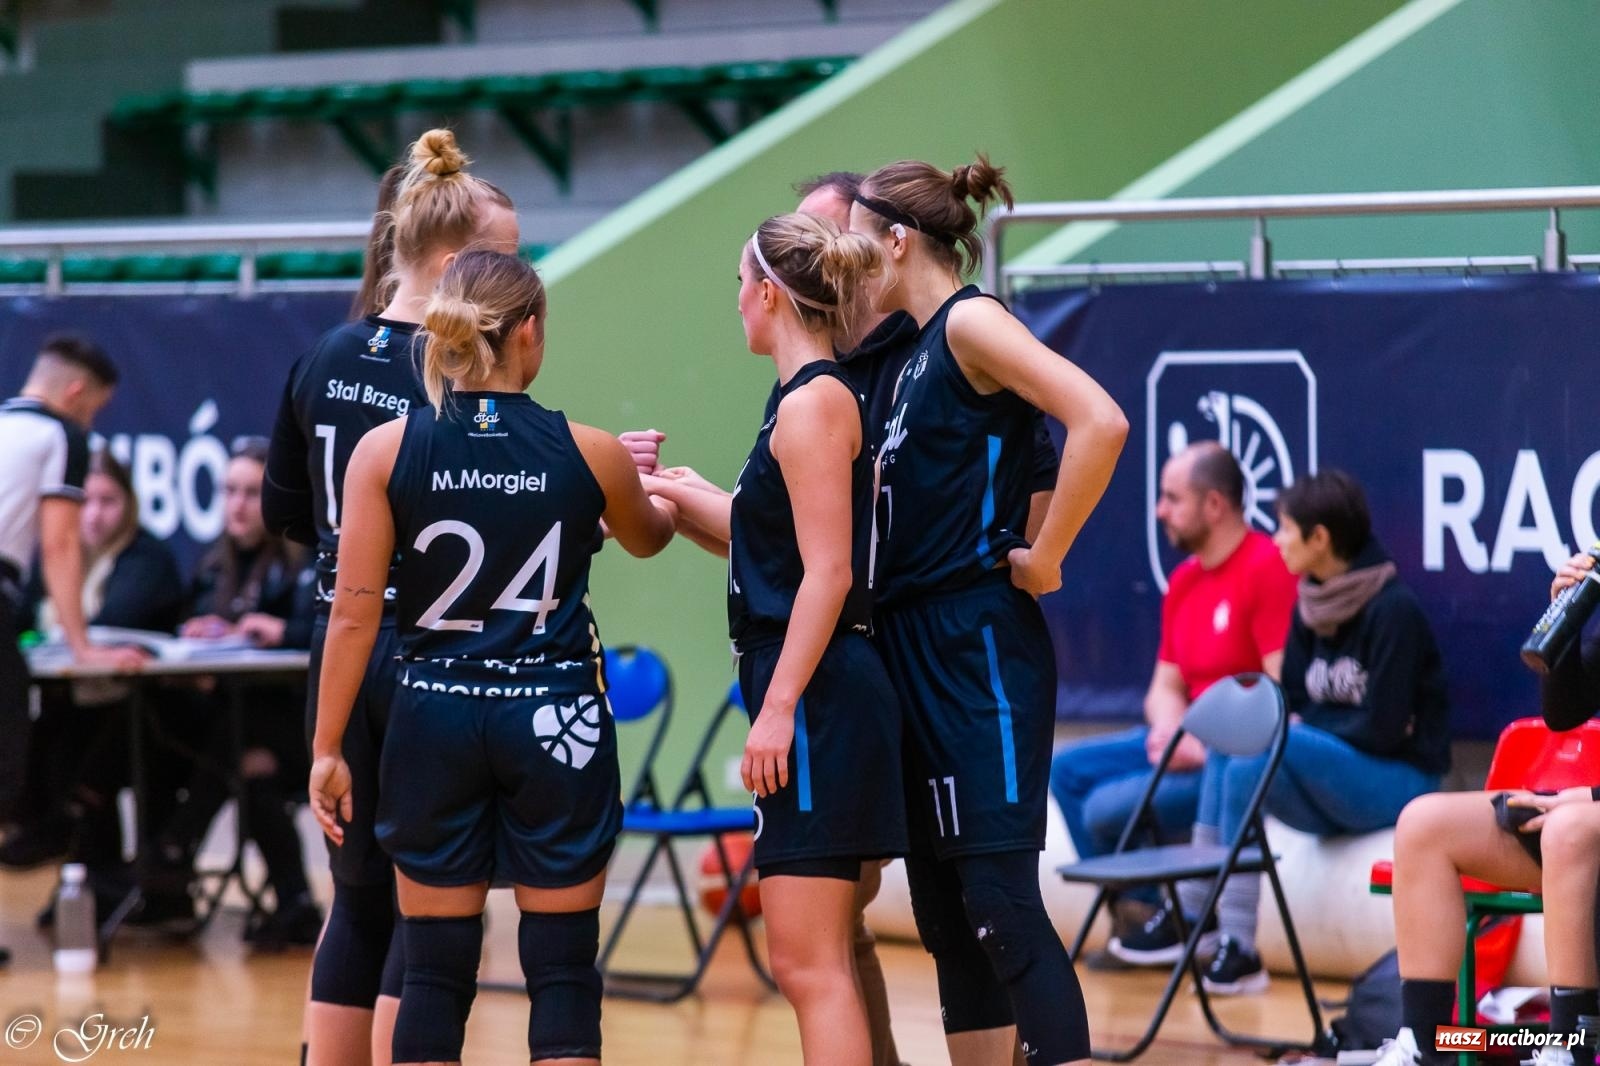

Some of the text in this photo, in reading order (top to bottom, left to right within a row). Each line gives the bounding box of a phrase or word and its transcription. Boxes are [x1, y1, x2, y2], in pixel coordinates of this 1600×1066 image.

[326, 379, 410, 417] Stal Brzeg
[473, 411, 500, 424] Stal
[432, 469, 547, 494] M.Morgiel
[413, 519, 562, 635] 24
[928, 776, 960, 838] 11
